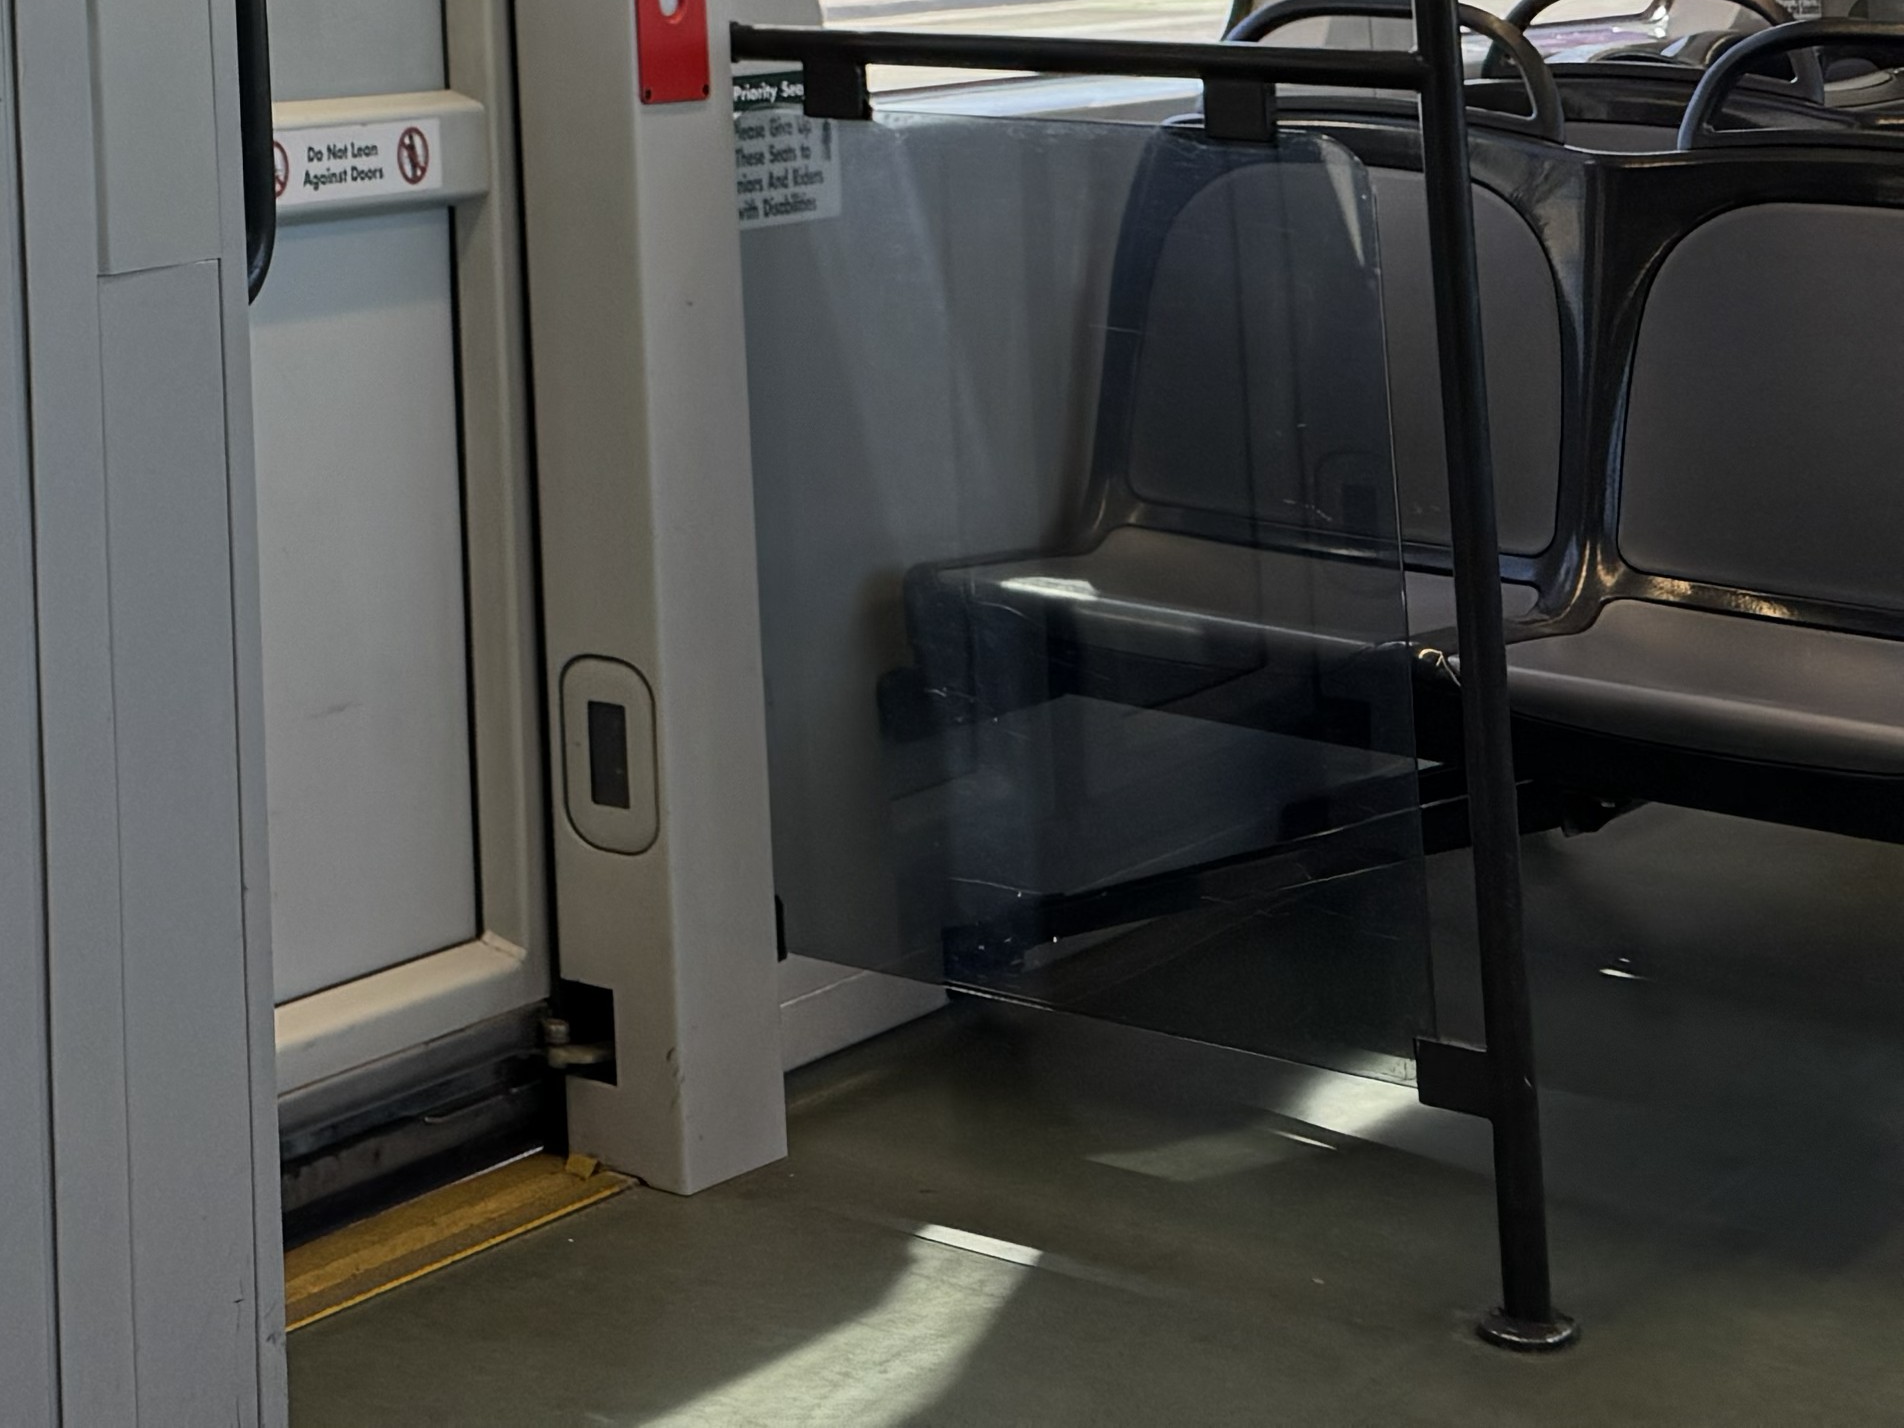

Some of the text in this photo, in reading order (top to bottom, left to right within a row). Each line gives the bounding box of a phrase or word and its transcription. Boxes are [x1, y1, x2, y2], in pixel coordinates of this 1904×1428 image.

[733, 81, 779, 104] Priority
[306, 139, 379, 165] Do Not Lean
[302, 164, 385, 192] Against Doors
